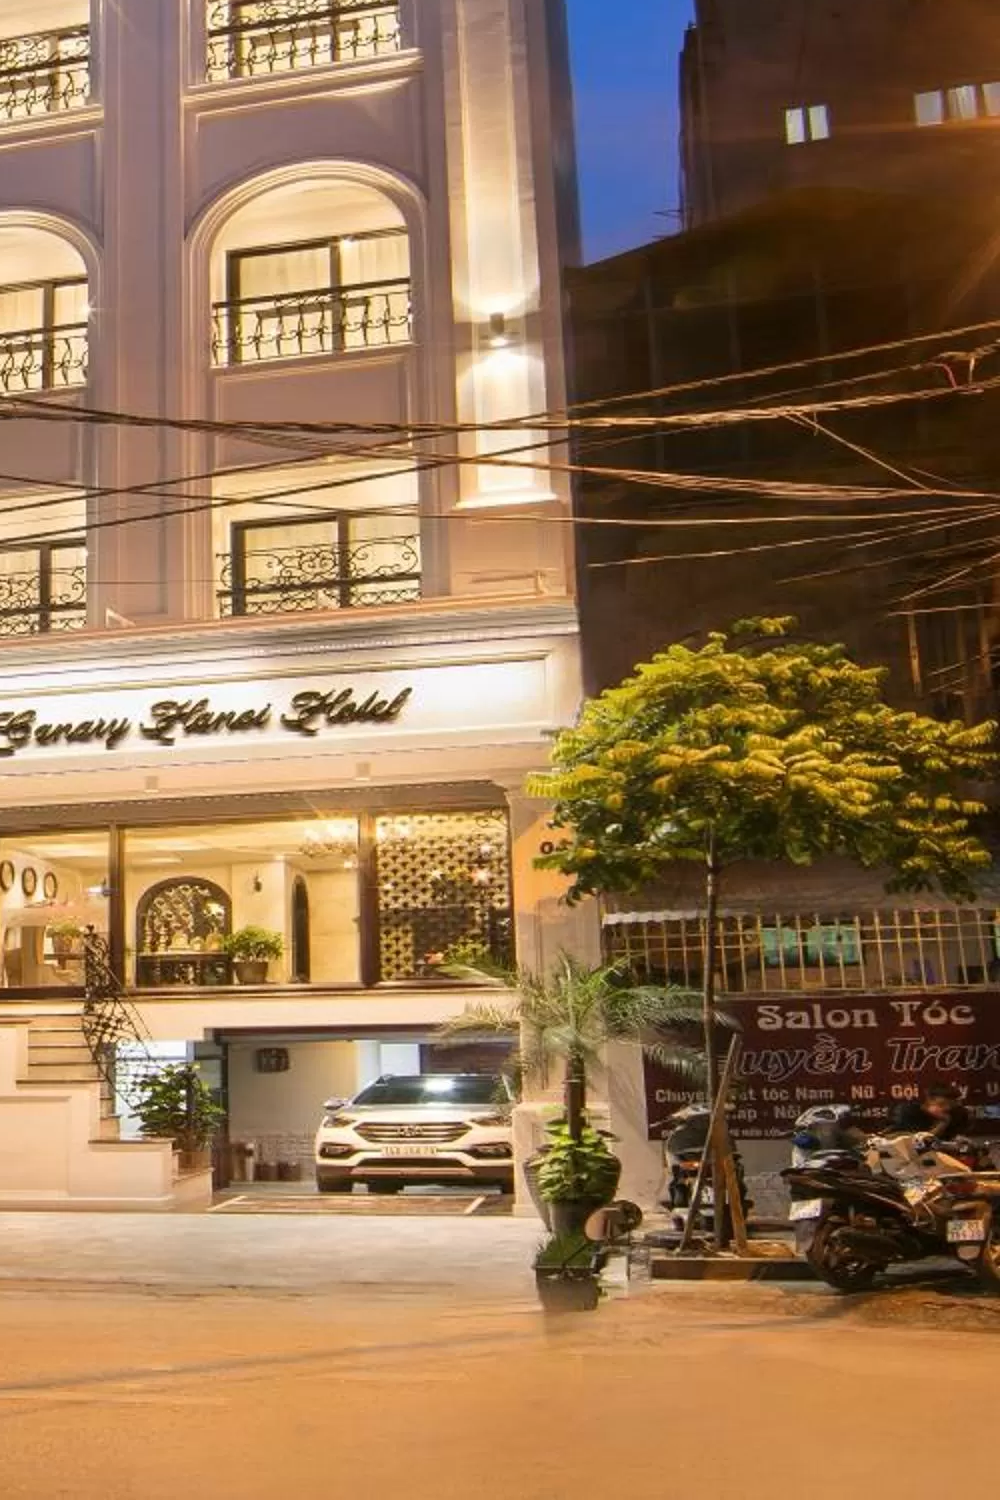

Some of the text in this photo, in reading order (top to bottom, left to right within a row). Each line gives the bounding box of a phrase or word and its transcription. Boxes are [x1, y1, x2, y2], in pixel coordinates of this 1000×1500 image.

[140, 700, 271, 746] Hanoi
[281, 687, 413, 736] Hotel
[757, 1000, 975, 1031] Salon Tóc
[733, 1033, 873, 1084] uyền
[795, 1087, 834, 1100] Nam
